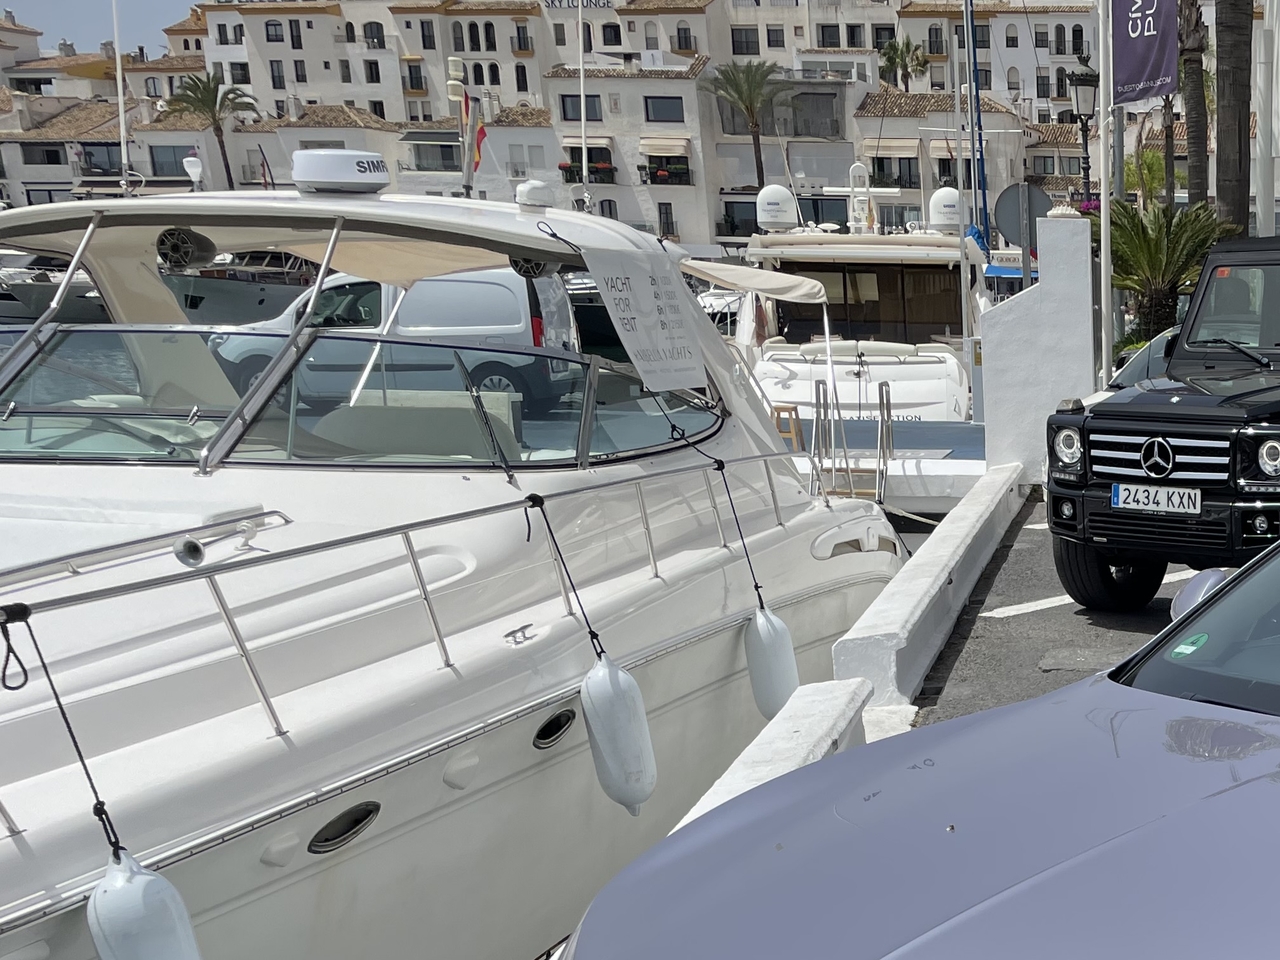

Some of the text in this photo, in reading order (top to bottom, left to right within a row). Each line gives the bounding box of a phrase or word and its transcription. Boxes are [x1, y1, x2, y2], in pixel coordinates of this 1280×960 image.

[545, 0, 612, 8] SKY LOUNGE
[603, 277, 632, 293] YACHT
[613, 297, 632, 313] FOR
[1122, 488, 1197, 510] 2434 KXN
